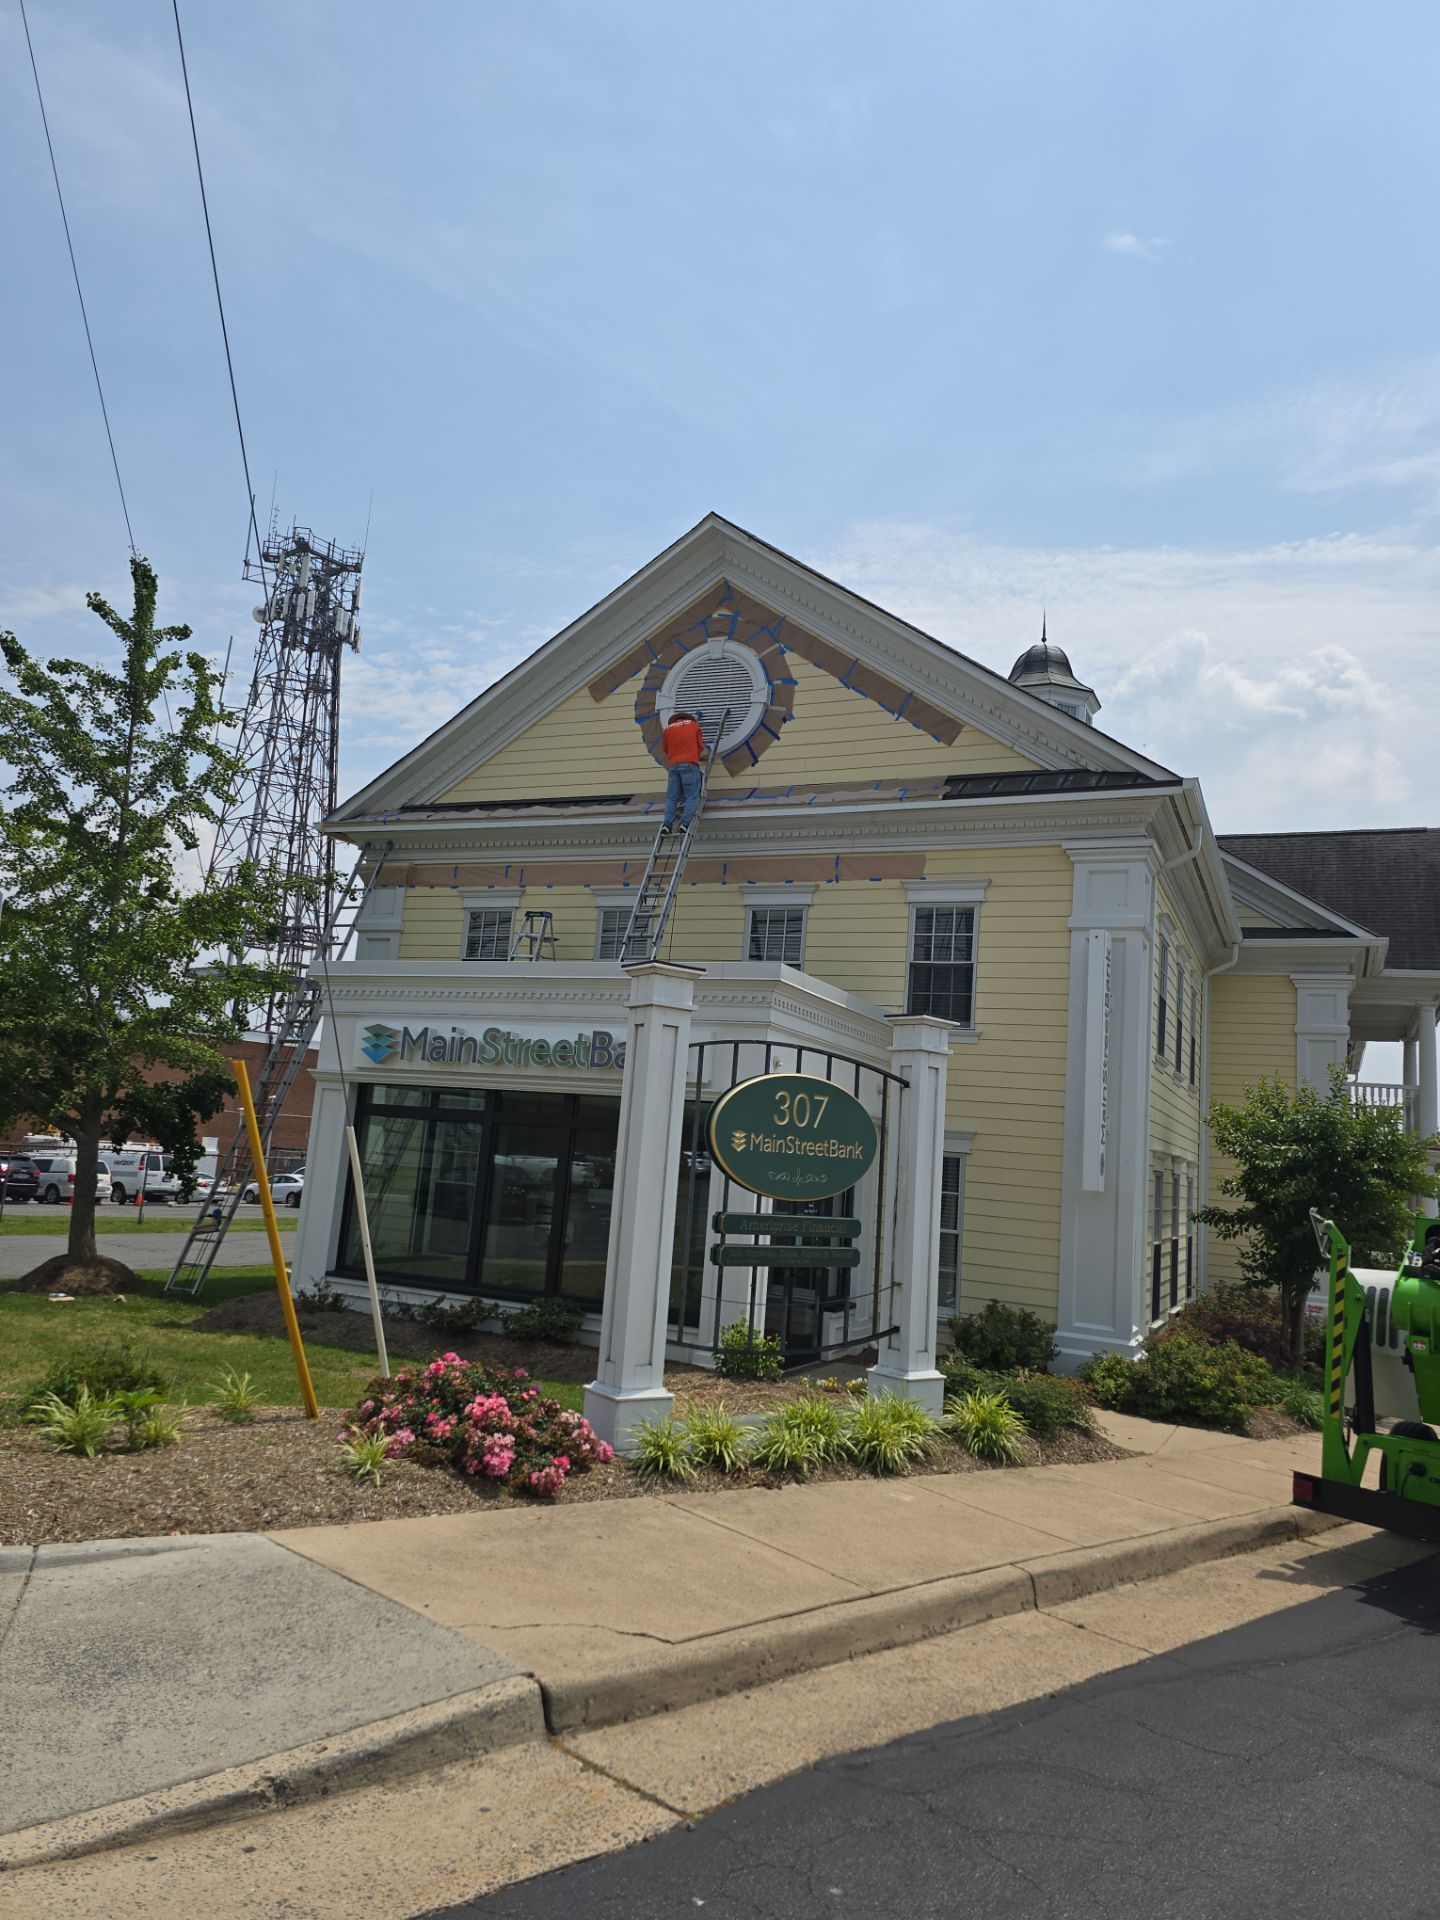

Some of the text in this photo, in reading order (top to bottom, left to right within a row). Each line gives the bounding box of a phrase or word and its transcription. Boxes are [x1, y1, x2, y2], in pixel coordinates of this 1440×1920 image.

[1101, 949, 1112, 1144] MainStreetBank
[774, 1091, 829, 1129] 307
[750, 1133, 863, 1160] MainStreetBank
[740, 1219, 848, 1234] Ameriprise Financial
